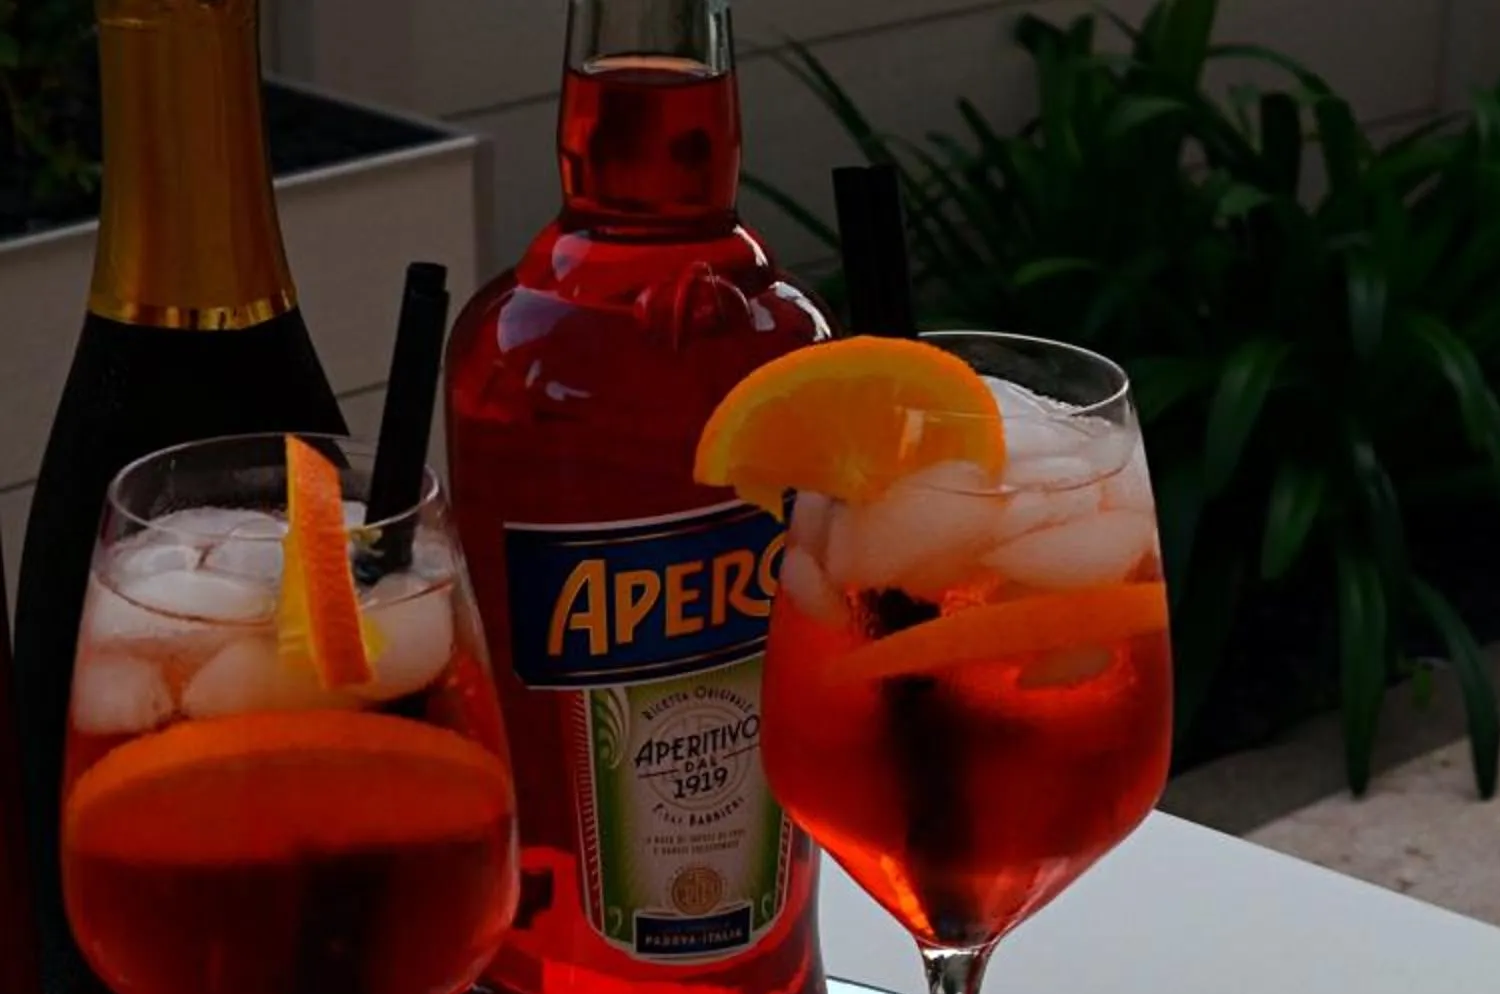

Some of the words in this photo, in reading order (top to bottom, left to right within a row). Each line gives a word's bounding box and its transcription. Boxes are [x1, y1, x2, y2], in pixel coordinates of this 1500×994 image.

[634, 714, 761, 768] APERITIVO
[685, 755, 717, 773] DAL
[673, 766, 728, 799] 1919
